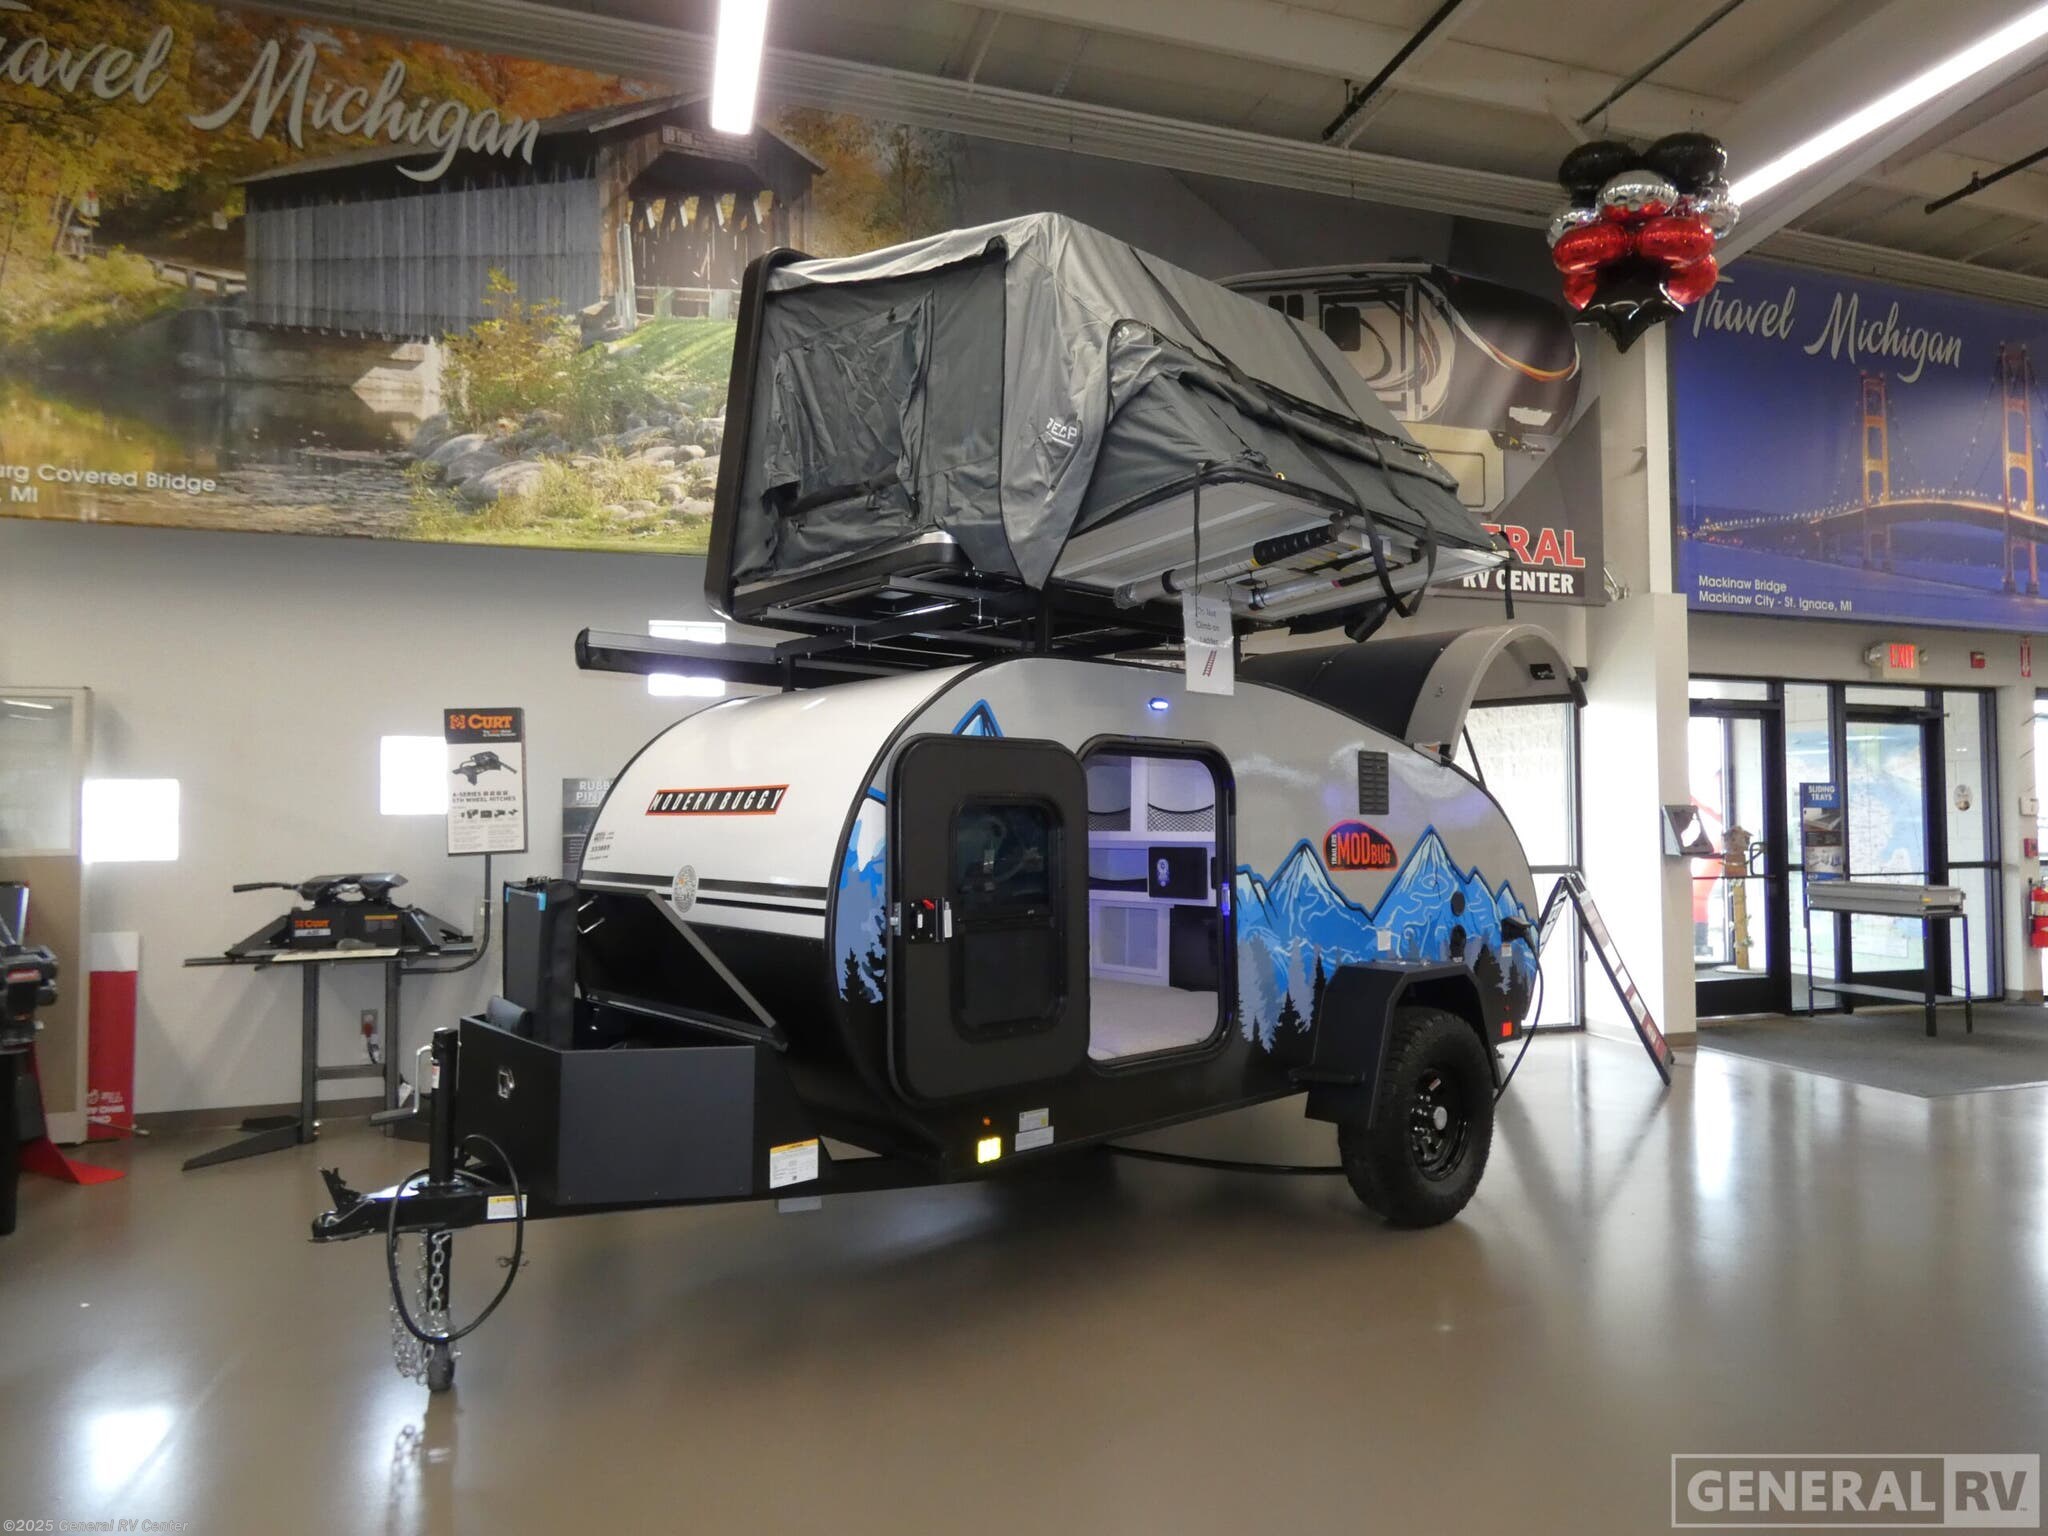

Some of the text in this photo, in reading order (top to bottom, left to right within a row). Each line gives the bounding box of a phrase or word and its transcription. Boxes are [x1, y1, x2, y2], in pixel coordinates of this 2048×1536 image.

[0, 20, 541, 182] avel Michigan
[1803, 291, 1962, 383] Michigan
[37, 463, 138, 487] Covered
[146, 472, 217, 494] Bridge
[1495, 569, 1575, 595] CENTER
[1698, 575, 1787, 594] Mackinaw Bridge
[1699, 590, 1752, 604] Mackinaw
[1754, 594, 1775, 608] City
[1840, 600, 1852, 611] MI
[1889, 643, 1916, 669] EXIT
[468, 714, 514, 729] CURT
[579, 780, 615, 791] RUBB
[1808, 785, 1835, 794] SLIDING
[649, 789, 783, 811] MODERN BUGGY
